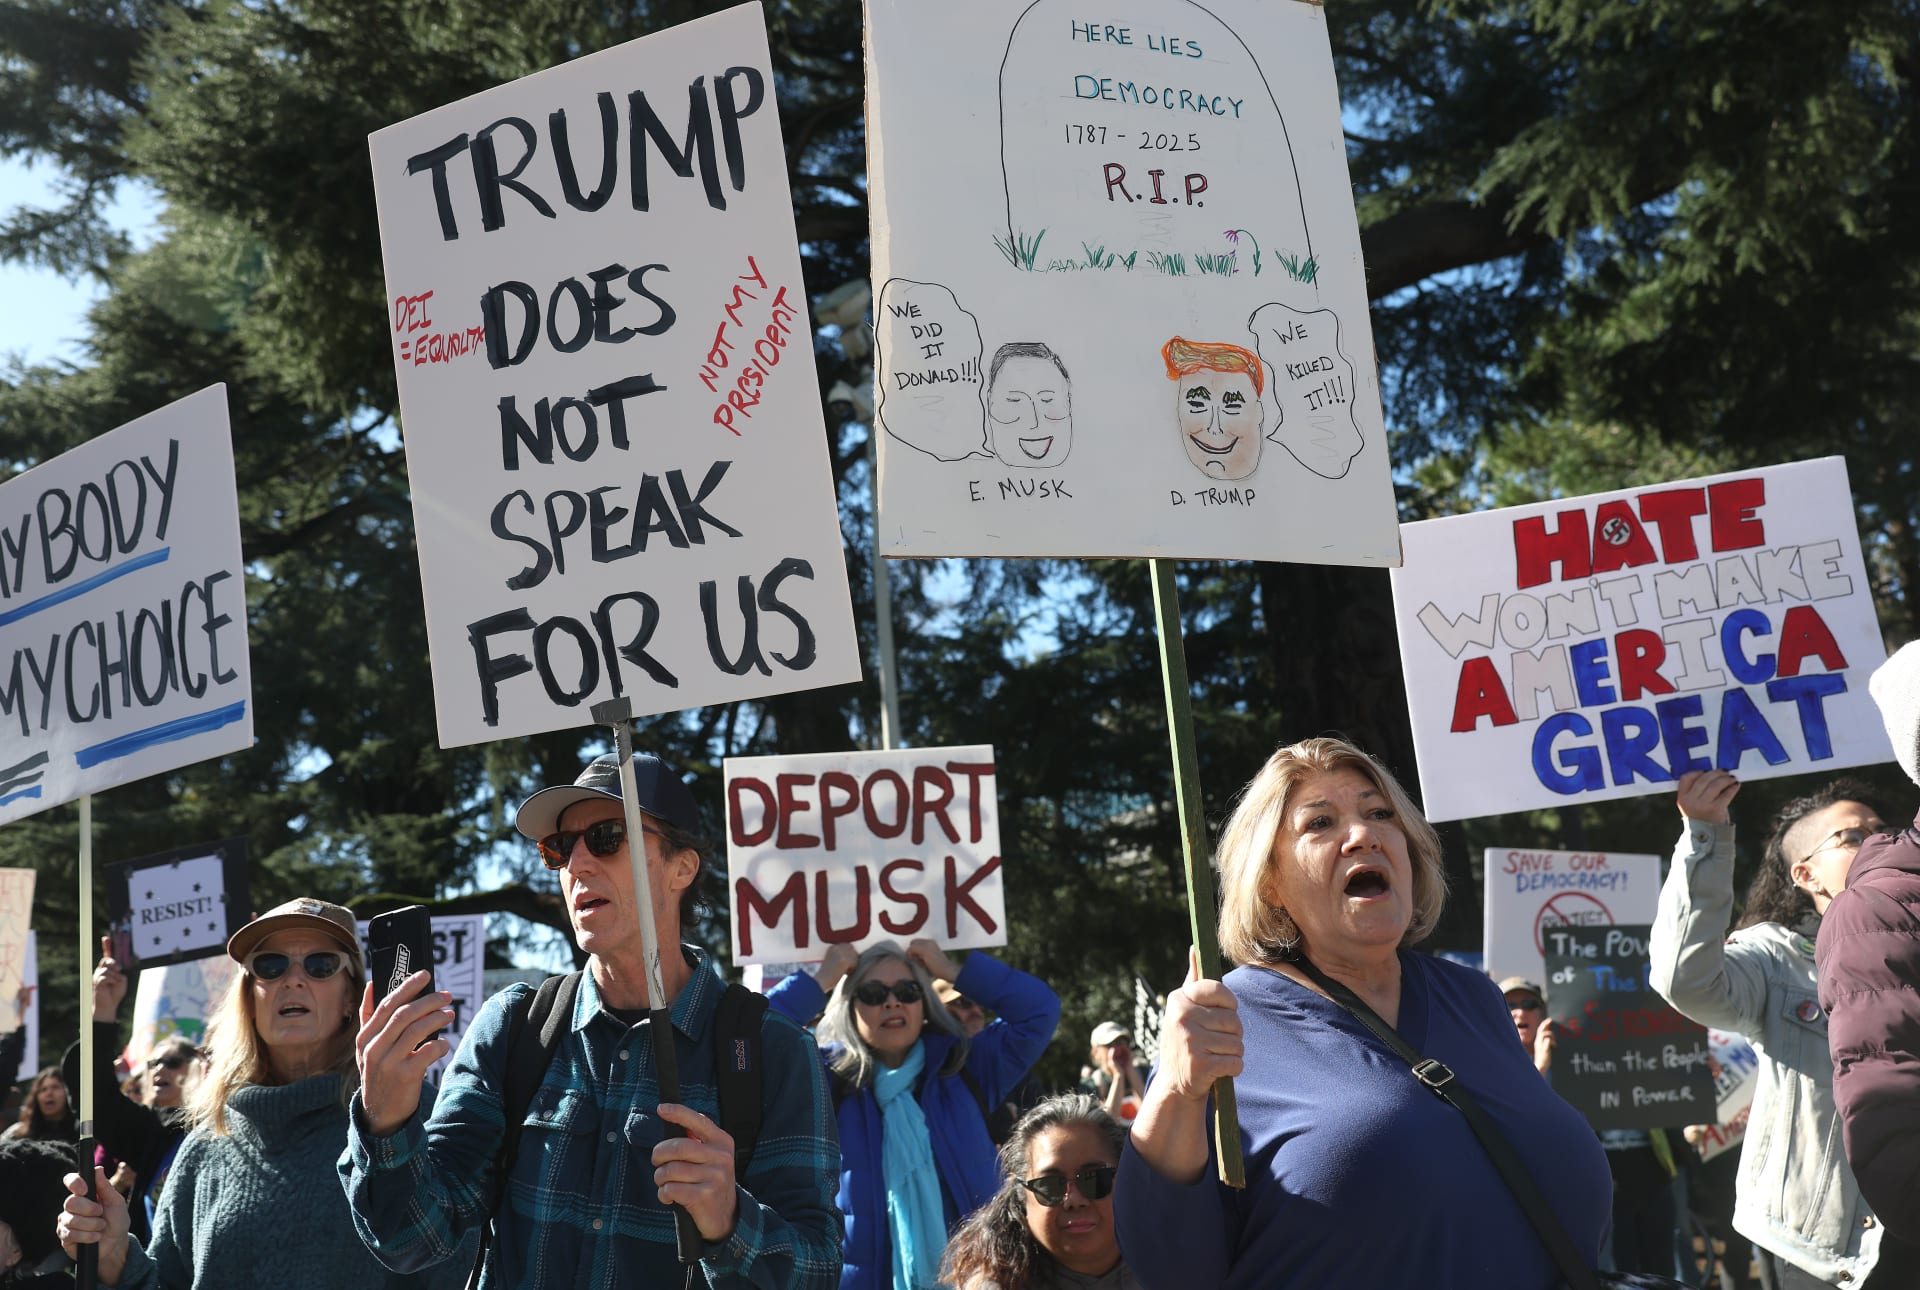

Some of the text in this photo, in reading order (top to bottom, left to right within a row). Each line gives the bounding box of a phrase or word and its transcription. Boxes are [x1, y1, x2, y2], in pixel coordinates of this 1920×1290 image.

[1071, 19, 1203, 58] HERE LIES
[1074, 74, 1243, 119] DEMOCRACY
[404, 66, 765, 241] TRUMP
[1065, 124, 1107, 145] 1787
[1138, 131, 1201, 152] 2025
[1103, 162, 1209, 208] R.I.P.
[395, 289, 434, 334] DEI
[480, 263, 677, 370] DOES
[698, 255, 768, 393] NOT MY
[887, 301, 922, 318] WE
[910, 322, 943, 340] DID
[920, 341, 945, 360] IT
[1272, 320, 1308, 345] WE
[893, 356, 977, 390] DONALD!!!
[1285, 356, 1334, 381] KILLED
[1303, 375, 1346, 411] IT!!!
[497, 373, 667, 471] NOT
[969, 478, 1073, 502] E. MUSK
[1171, 487, 1256, 507] D. TRUMP
[37, 438, 179, 584] BODY
[490, 461, 743, 590] SPEAK
[1513, 478, 1766, 590] HATE
[1416, 538, 1854, 660] WON'T MAKE
[0, 570, 239, 738] MY CHOICE
[467, 557, 816, 727] FOR US
[1450, 604, 1850, 734] AMERICA
[1531, 672, 1848, 796] GREAT
[728, 761, 995, 851] DEPORT
[1502, 850, 1611, 875] SAVE OUR
[1516, 869, 1629, 894] DEMOCRACY!
[140, 896, 213, 926] RESIST!
[735, 856, 1001, 956] MUSK
[1550, 932, 1598, 959] The
[1552, 965, 1576, 985] of
[1588, 964, 1639, 993] The
[1570, 1052, 1617, 1075] than
[1621, 1050, 1658, 1072] the
[1599, 1090, 1620, 1109] IN
